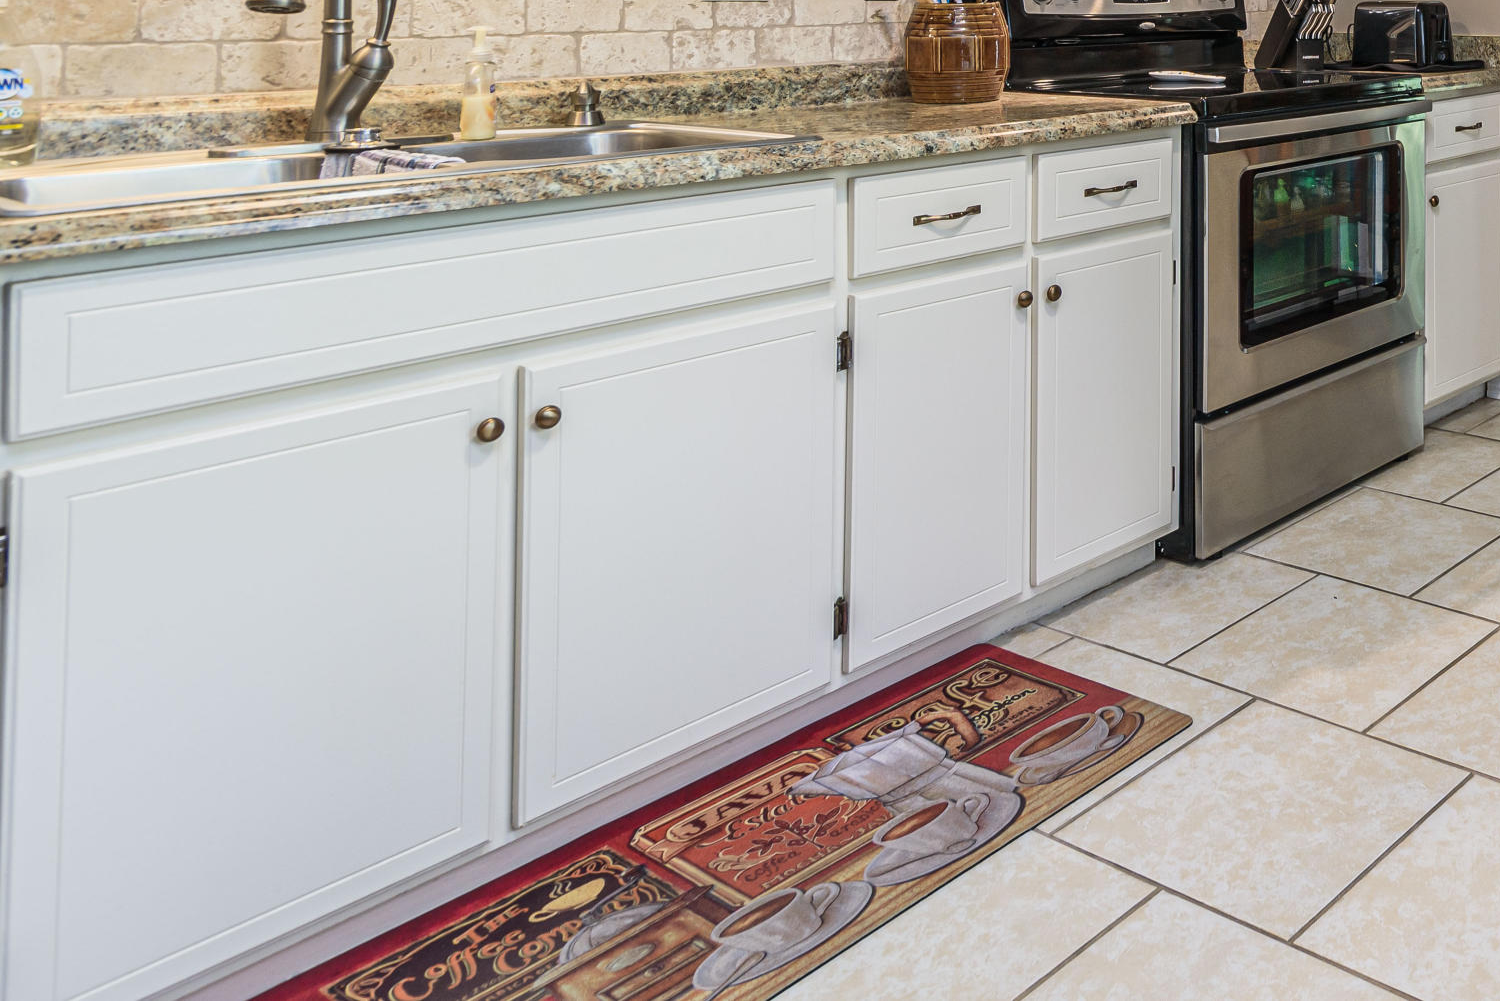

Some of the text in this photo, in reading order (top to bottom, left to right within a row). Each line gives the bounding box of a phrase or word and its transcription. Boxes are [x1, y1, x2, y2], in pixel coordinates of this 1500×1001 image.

[0, 78, 24, 91] WN
[671, 768, 817, 839] JAVA
[452, 904, 529, 945] THE
[493, 885, 643, 975] Compny
[388, 929, 526, 1001] Coffee
